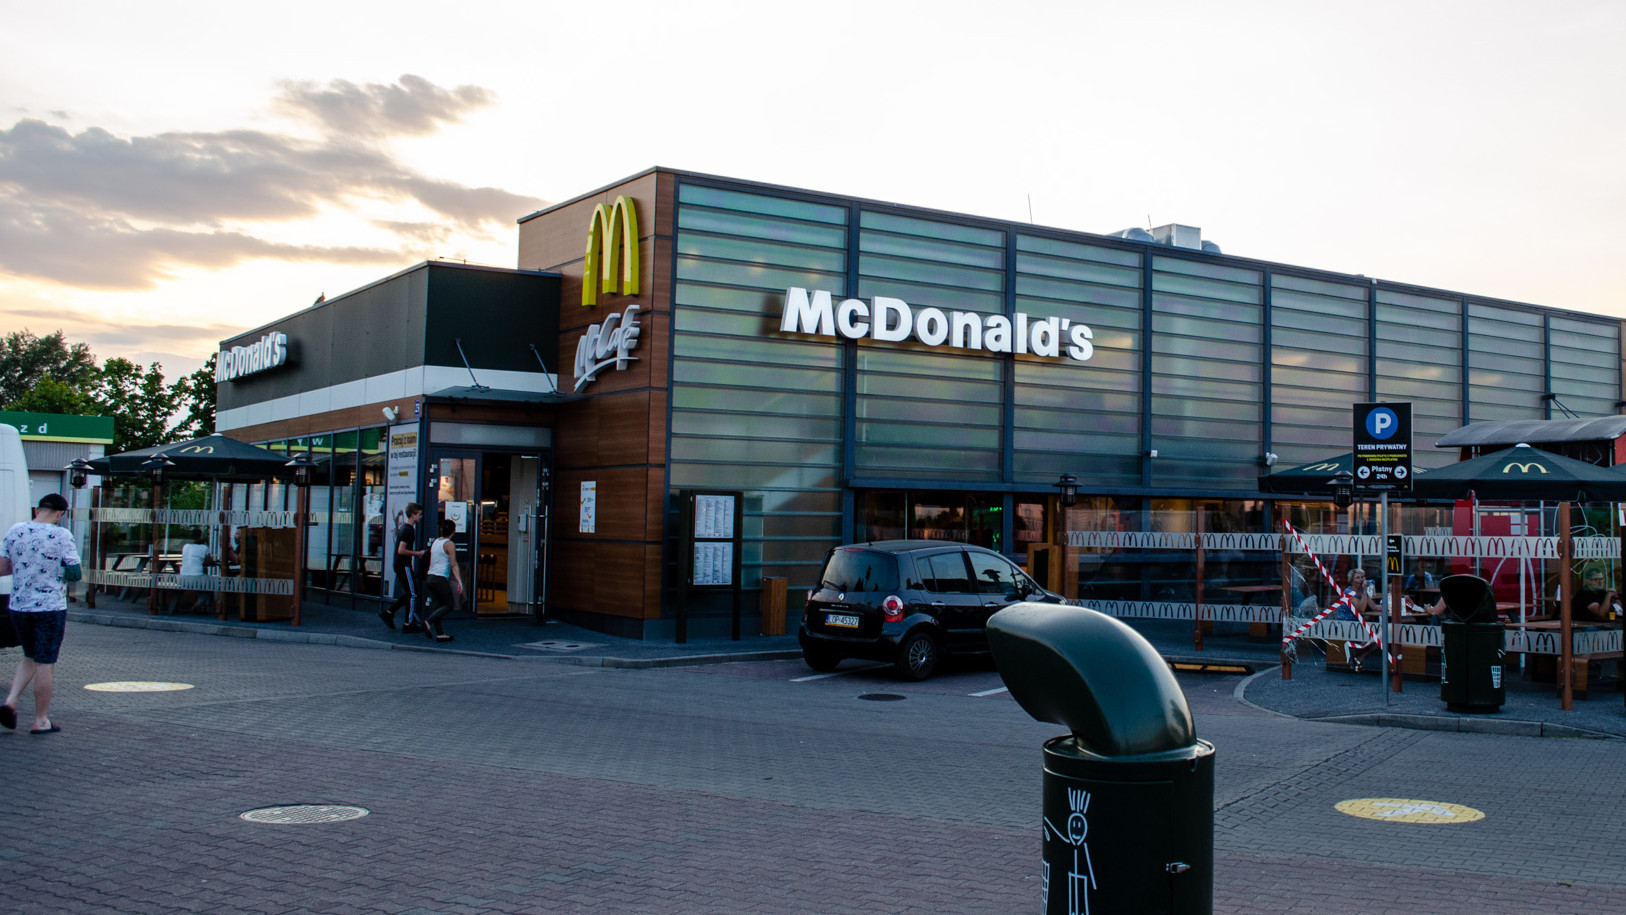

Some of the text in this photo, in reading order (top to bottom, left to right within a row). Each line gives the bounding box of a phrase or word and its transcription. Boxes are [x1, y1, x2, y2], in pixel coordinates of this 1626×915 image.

[780, 287, 1094, 361] McDonald's
[214, 331, 287, 383] McDonald's
[1375, 413, 1391, 434] P
[841, 616, 858, 625] 45327
